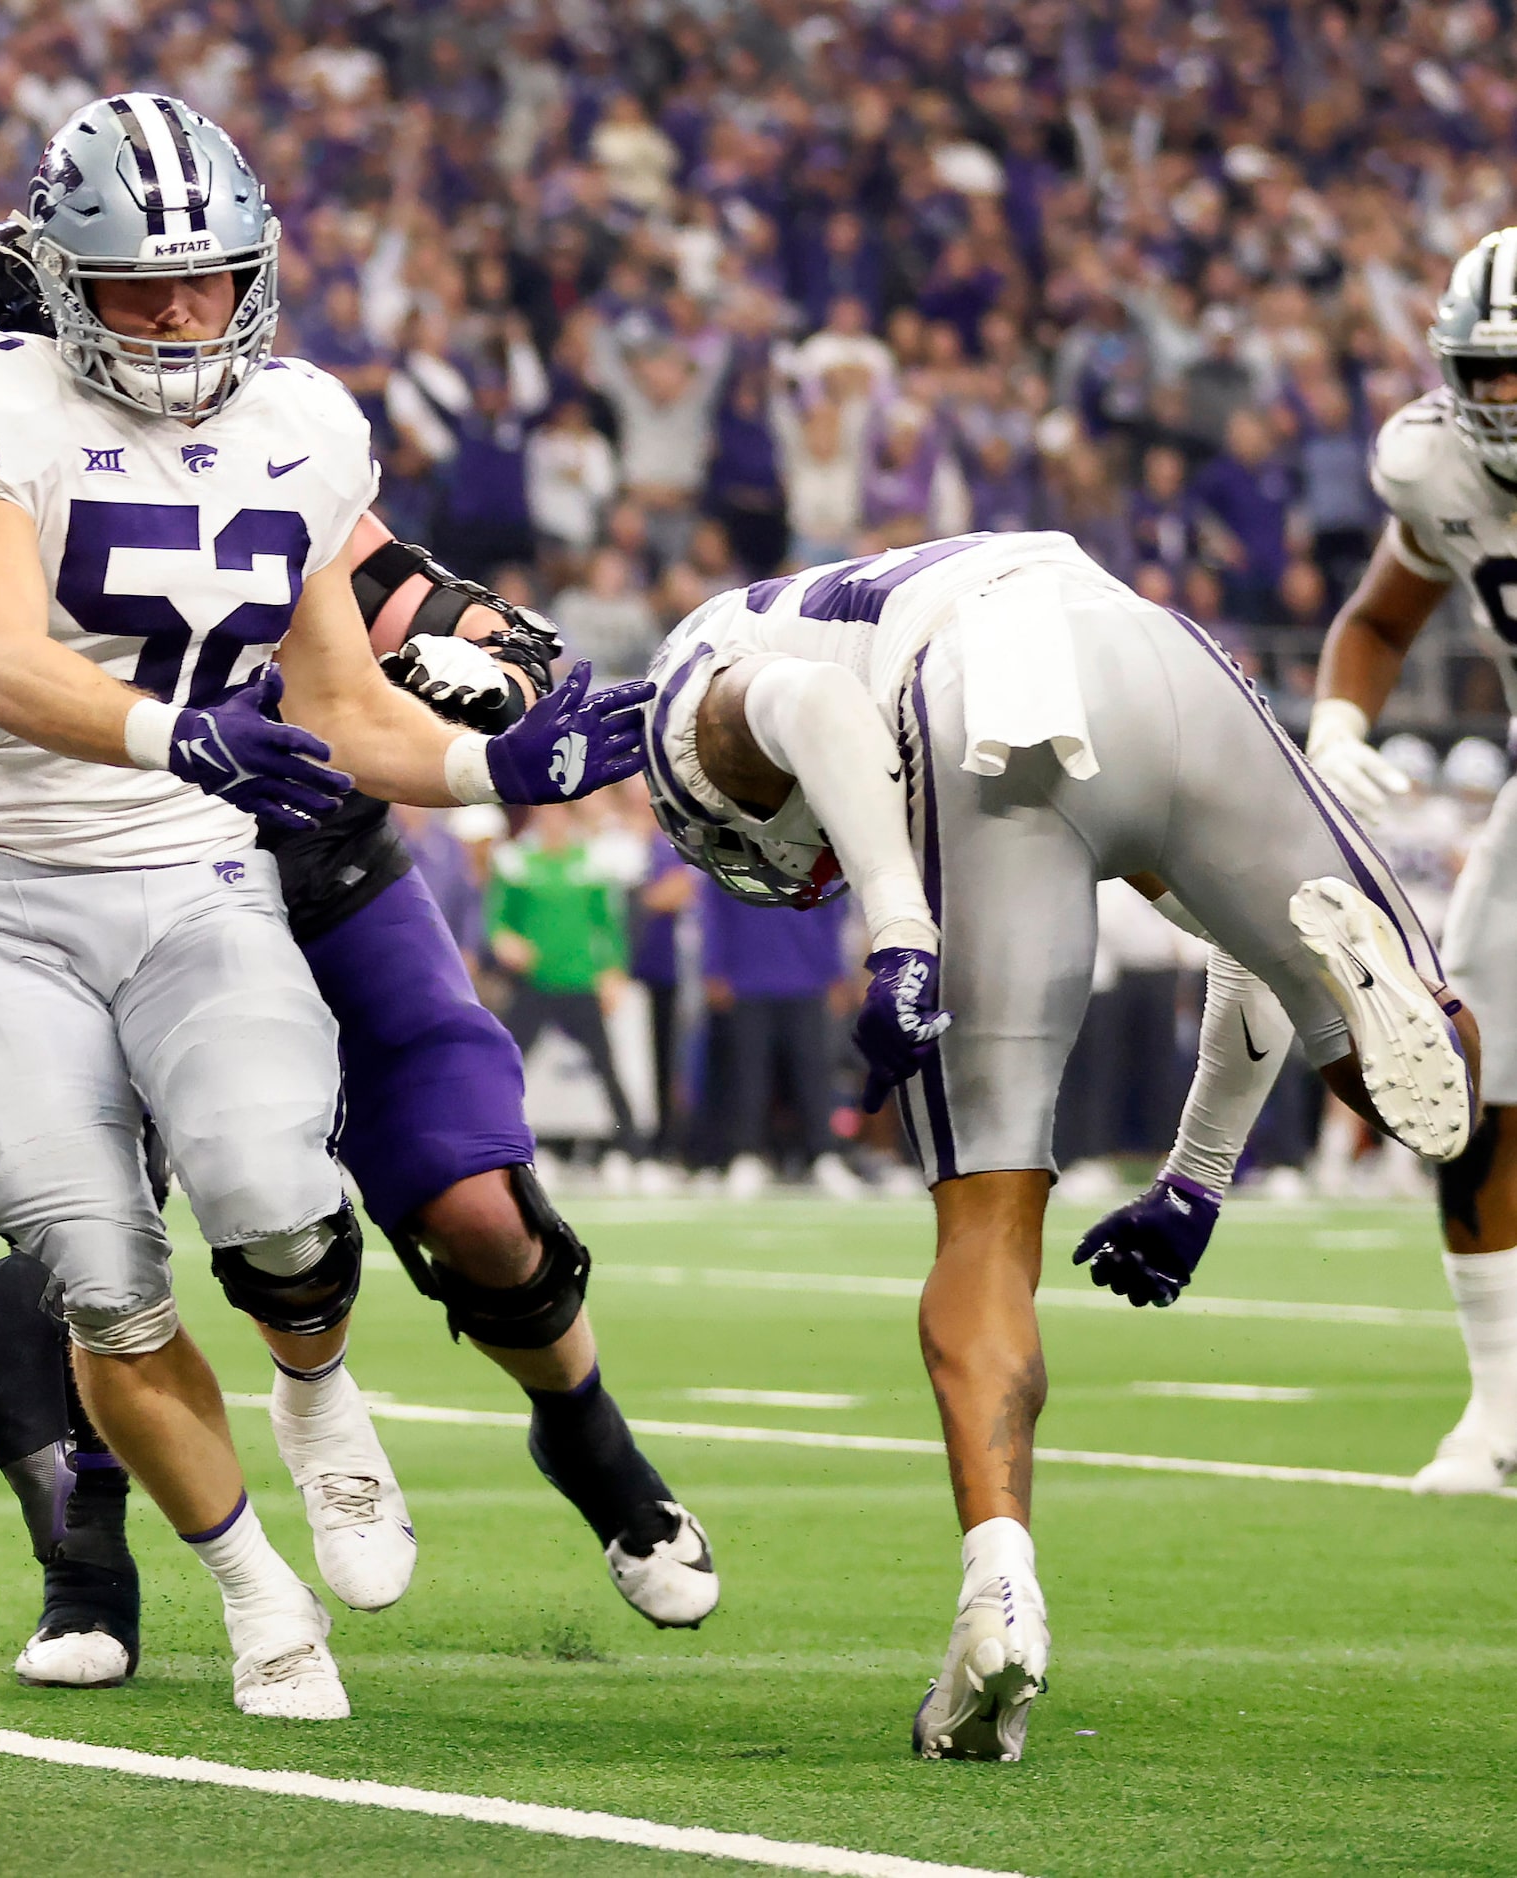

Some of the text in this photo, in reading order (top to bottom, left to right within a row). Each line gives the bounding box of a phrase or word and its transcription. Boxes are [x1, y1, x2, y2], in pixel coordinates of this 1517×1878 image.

[154, 238, 212, 257] K-STATE
[80, 446, 127, 473] XII
[56, 498, 312, 709] 52
